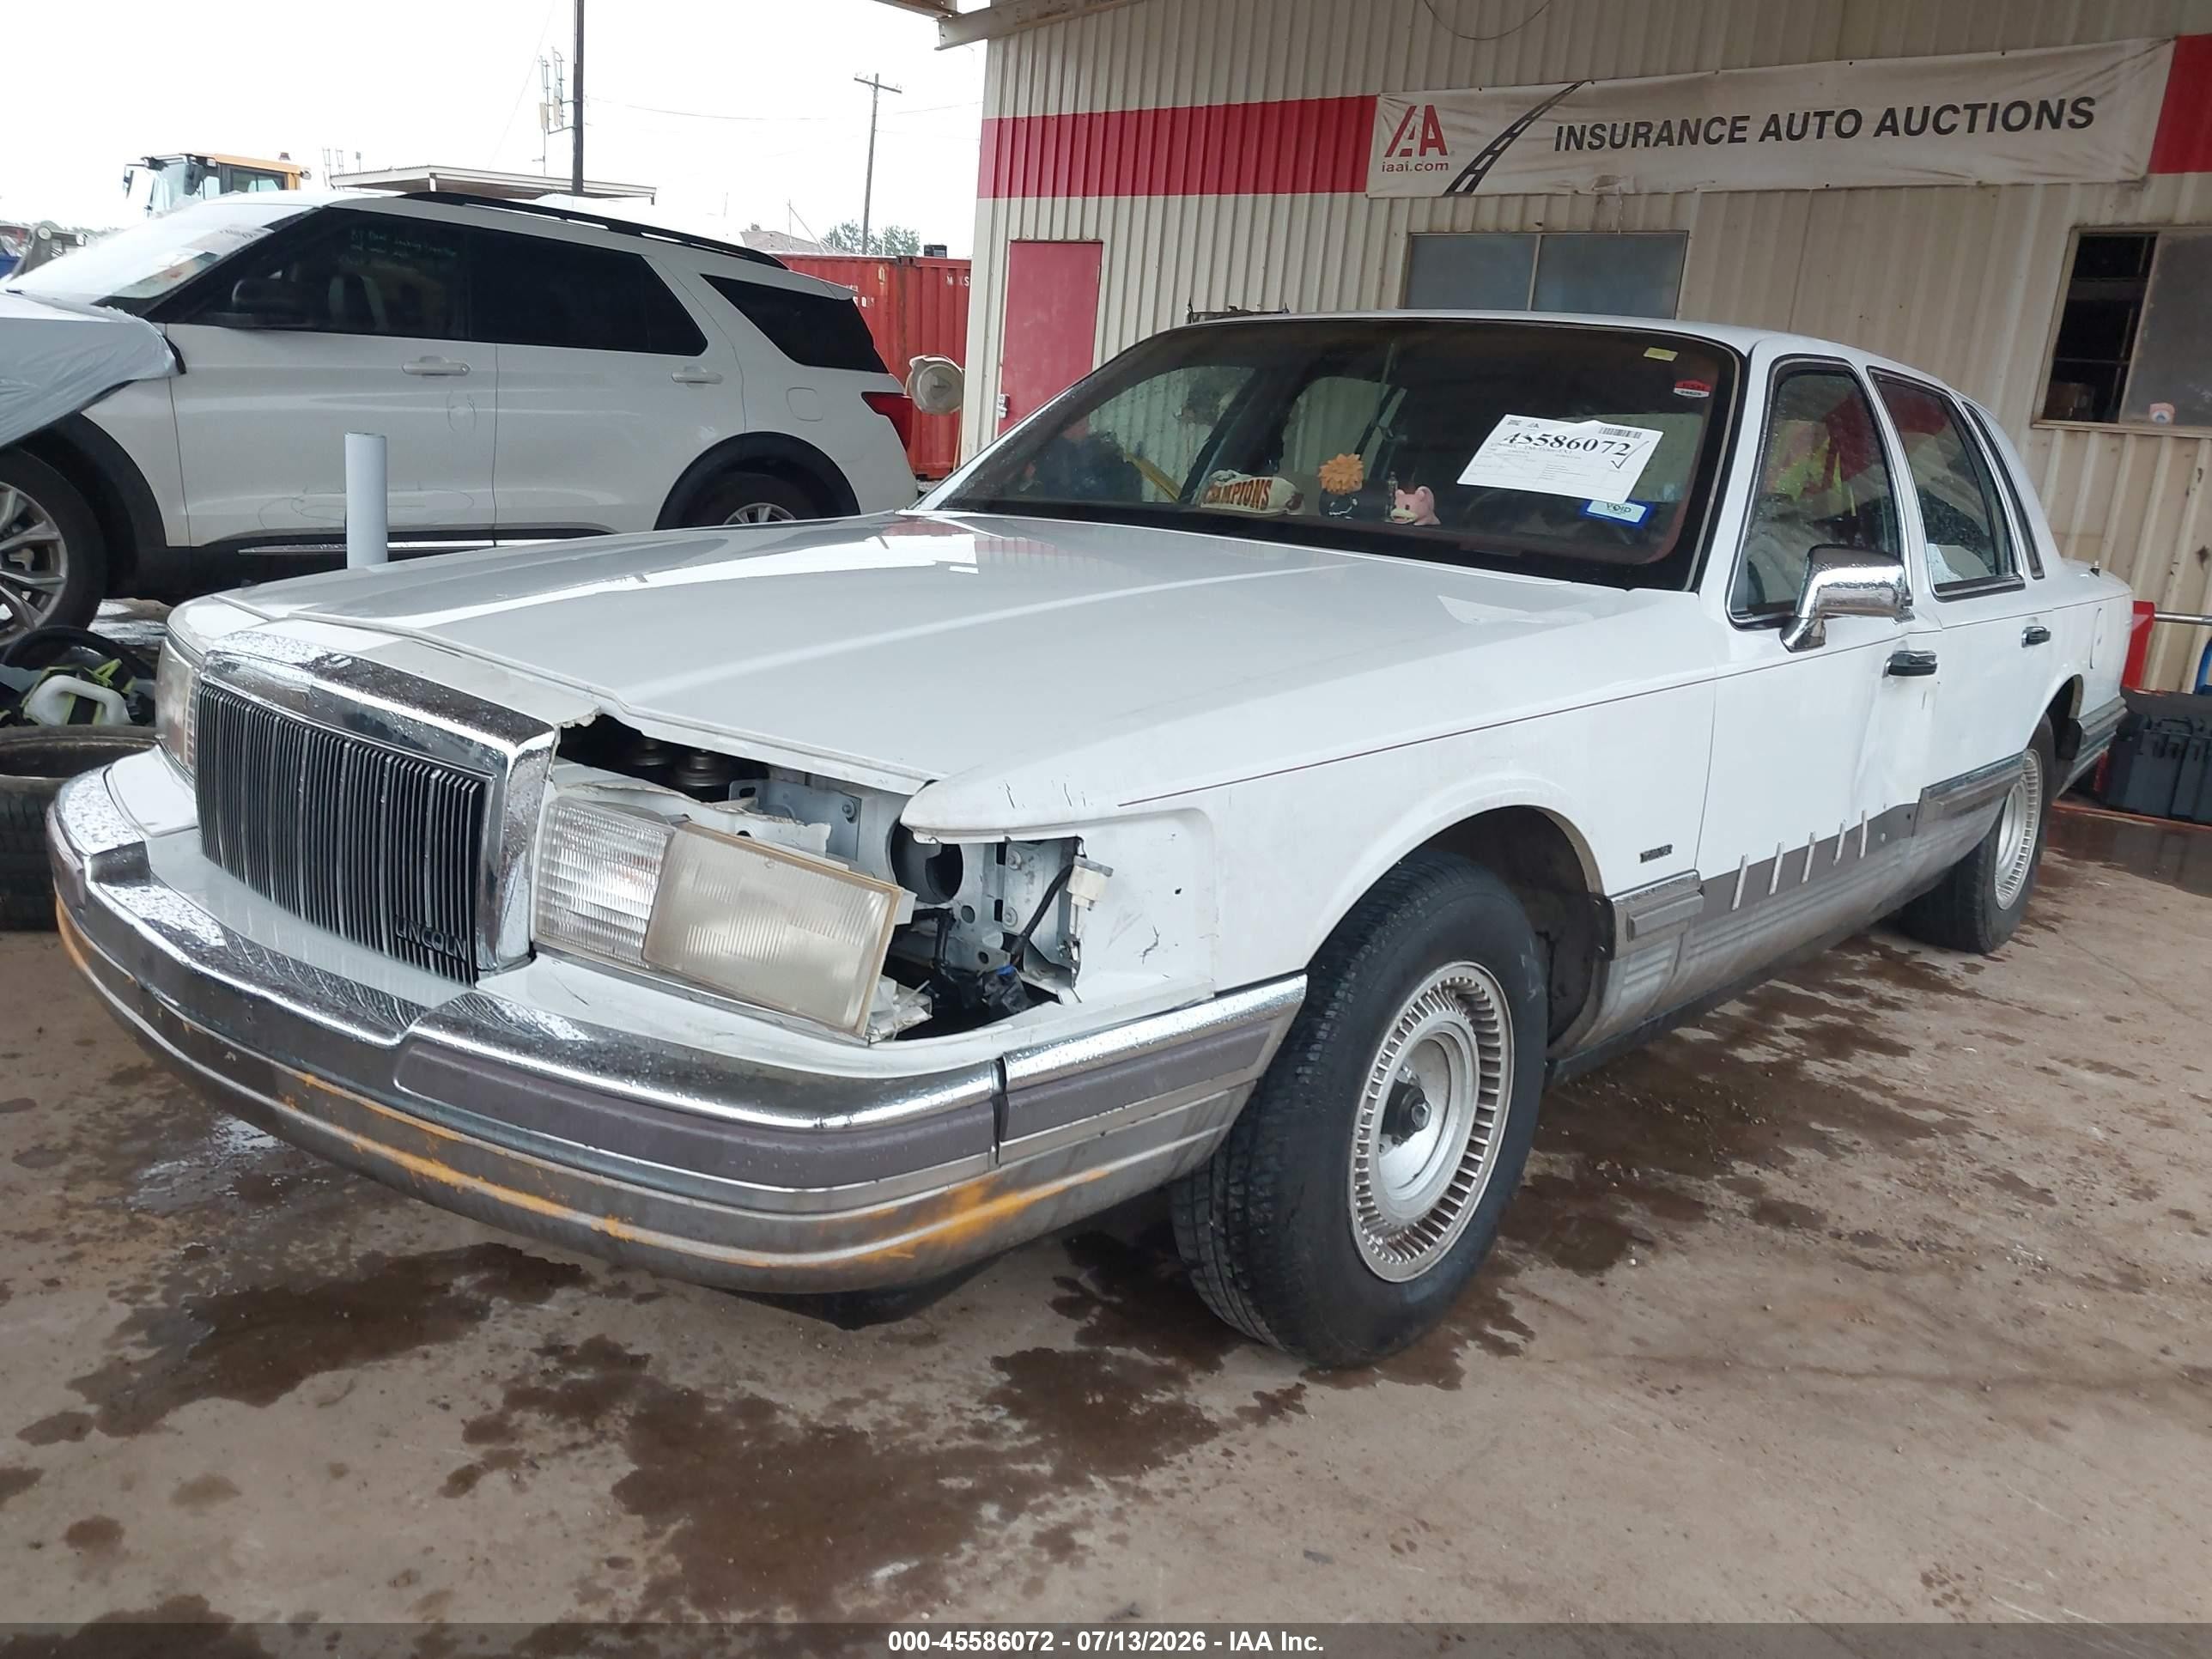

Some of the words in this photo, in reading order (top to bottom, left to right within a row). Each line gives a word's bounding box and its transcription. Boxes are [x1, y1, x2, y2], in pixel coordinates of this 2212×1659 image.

[1384, 105, 1449, 157] IAA
[1555, 115, 1748, 152] INSURANCE
[1758, 108, 1863, 143] AUTO
[1874, 97, 2095, 137] AUCTIONS
[1382, 161, 1449, 173] iaai.com
[1503, 431, 1632, 457] 45586072
[1606, 501, 1632, 514] VOID
[395, 915, 467, 963] LINCOLN
